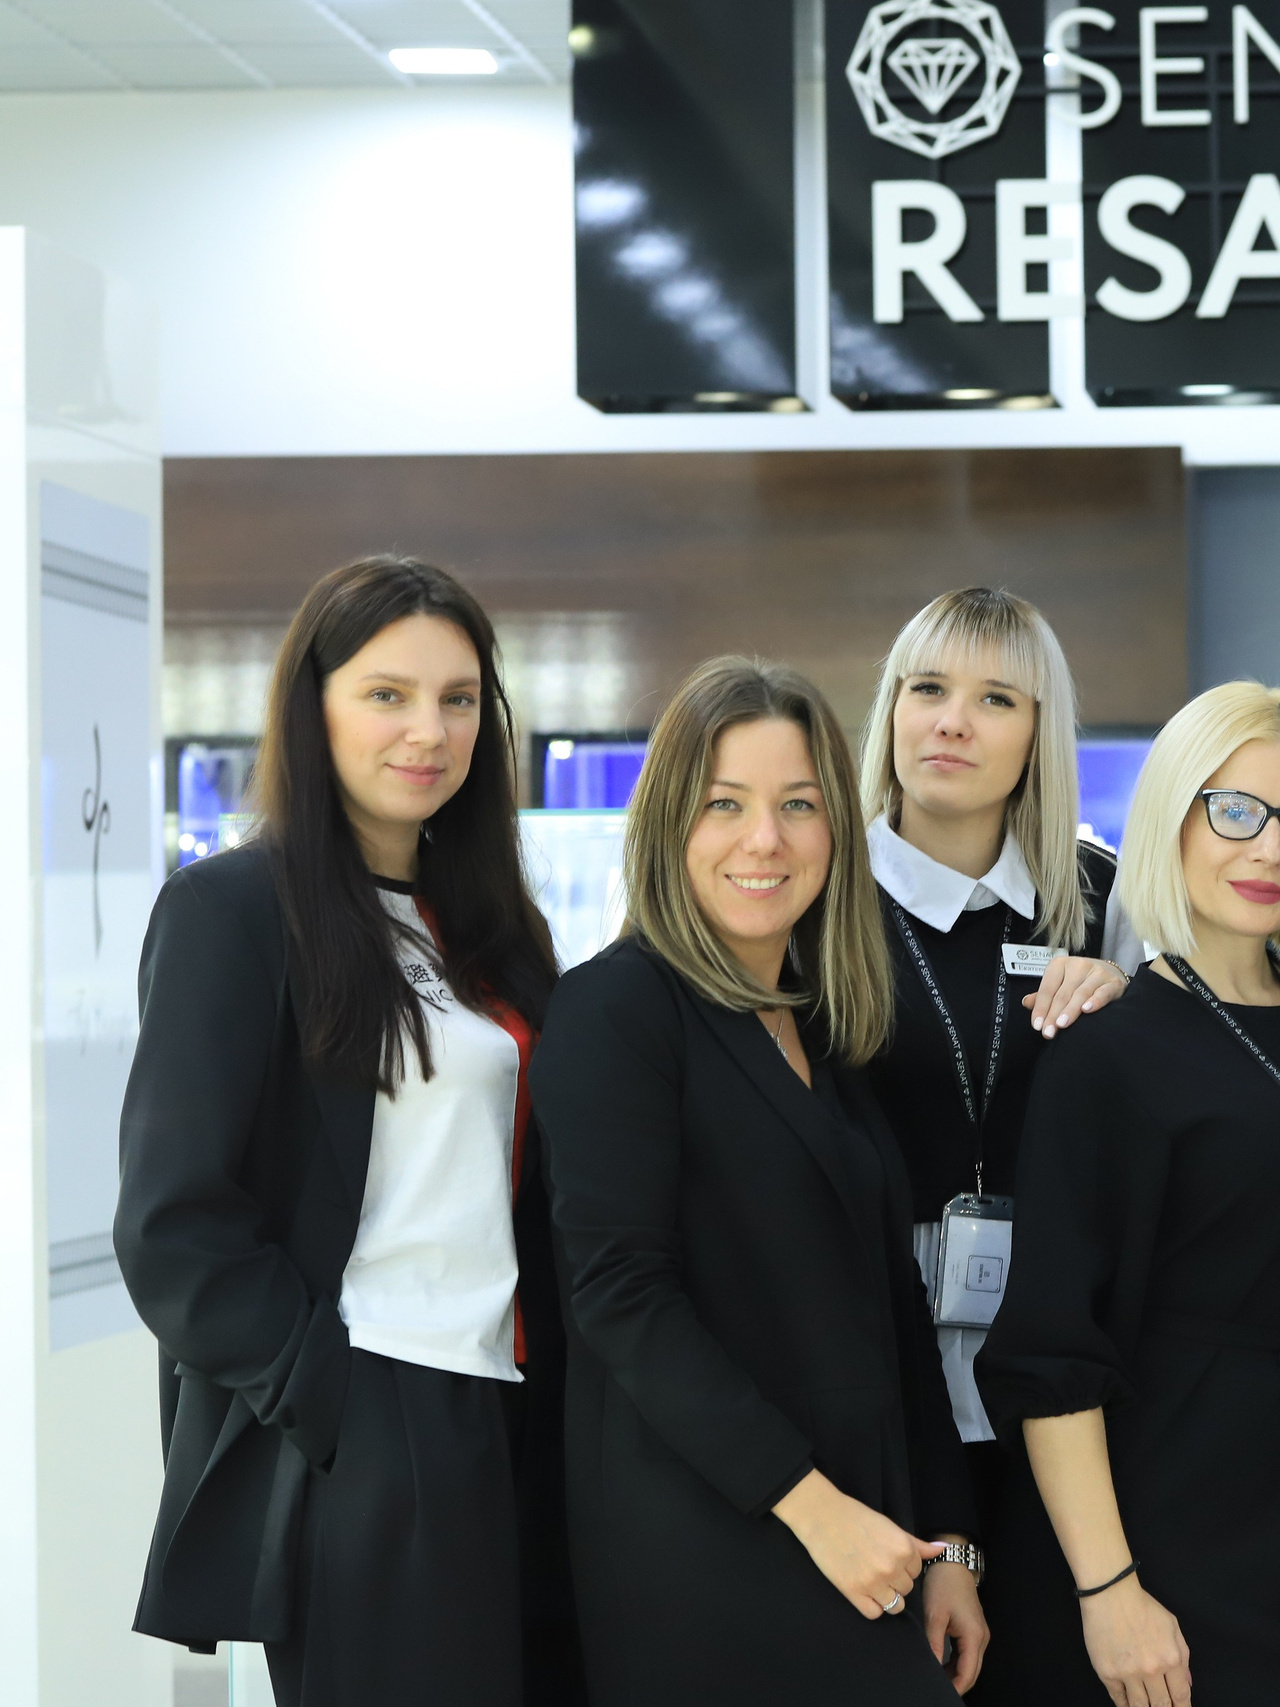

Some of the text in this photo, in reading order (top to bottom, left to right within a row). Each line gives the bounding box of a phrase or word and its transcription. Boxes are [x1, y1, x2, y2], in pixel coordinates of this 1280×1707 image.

[908, 938, 922, 958] SENAT
[921, 967, 935, 988] SENAT
[1192, 981, 1213, 1002] SENAT
[934, 996, 949, 1016] SENAT
[1217, 1008, 1237, 1028] SENAT
[947, 1025, 961, 1049] SENAT
[992, 1025, 1001, 1049] SENAT
[1241, 1035, 1261, 1055] SENAT
[956, 1061, 968, 1085] SENAT
[986, 1060, 996, 1085] SENAT
